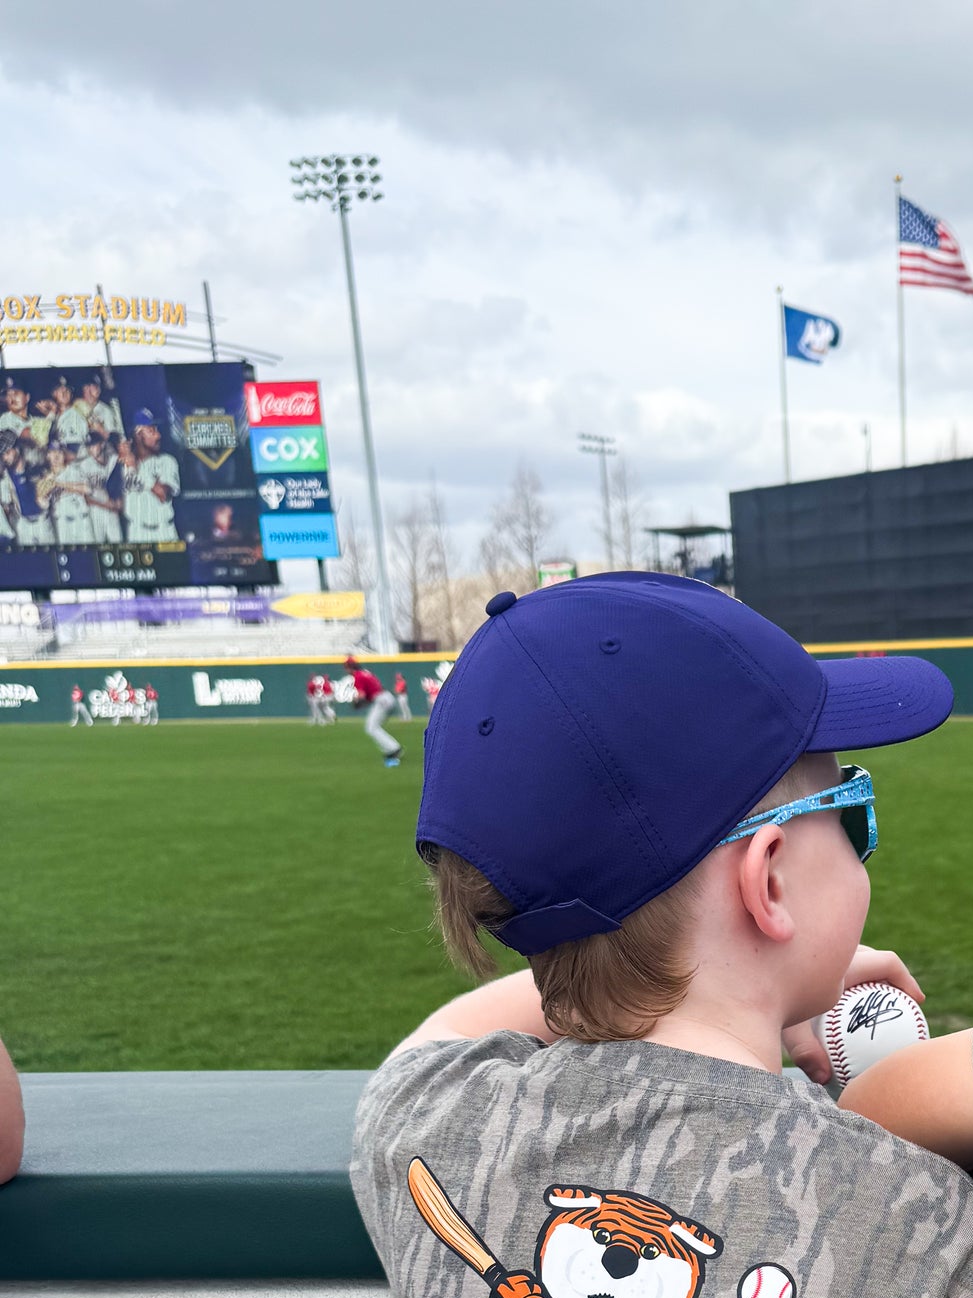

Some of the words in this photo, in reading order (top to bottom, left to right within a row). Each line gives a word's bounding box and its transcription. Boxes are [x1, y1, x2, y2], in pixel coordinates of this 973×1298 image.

[0, 295, 42, 321] OX
[56, 294, 187, 326] STADIUM
[0, 324, 98, 344] ERTMAN
[104, 324, 167, 346] FIELD
[259, 436, 321, 462] COX
